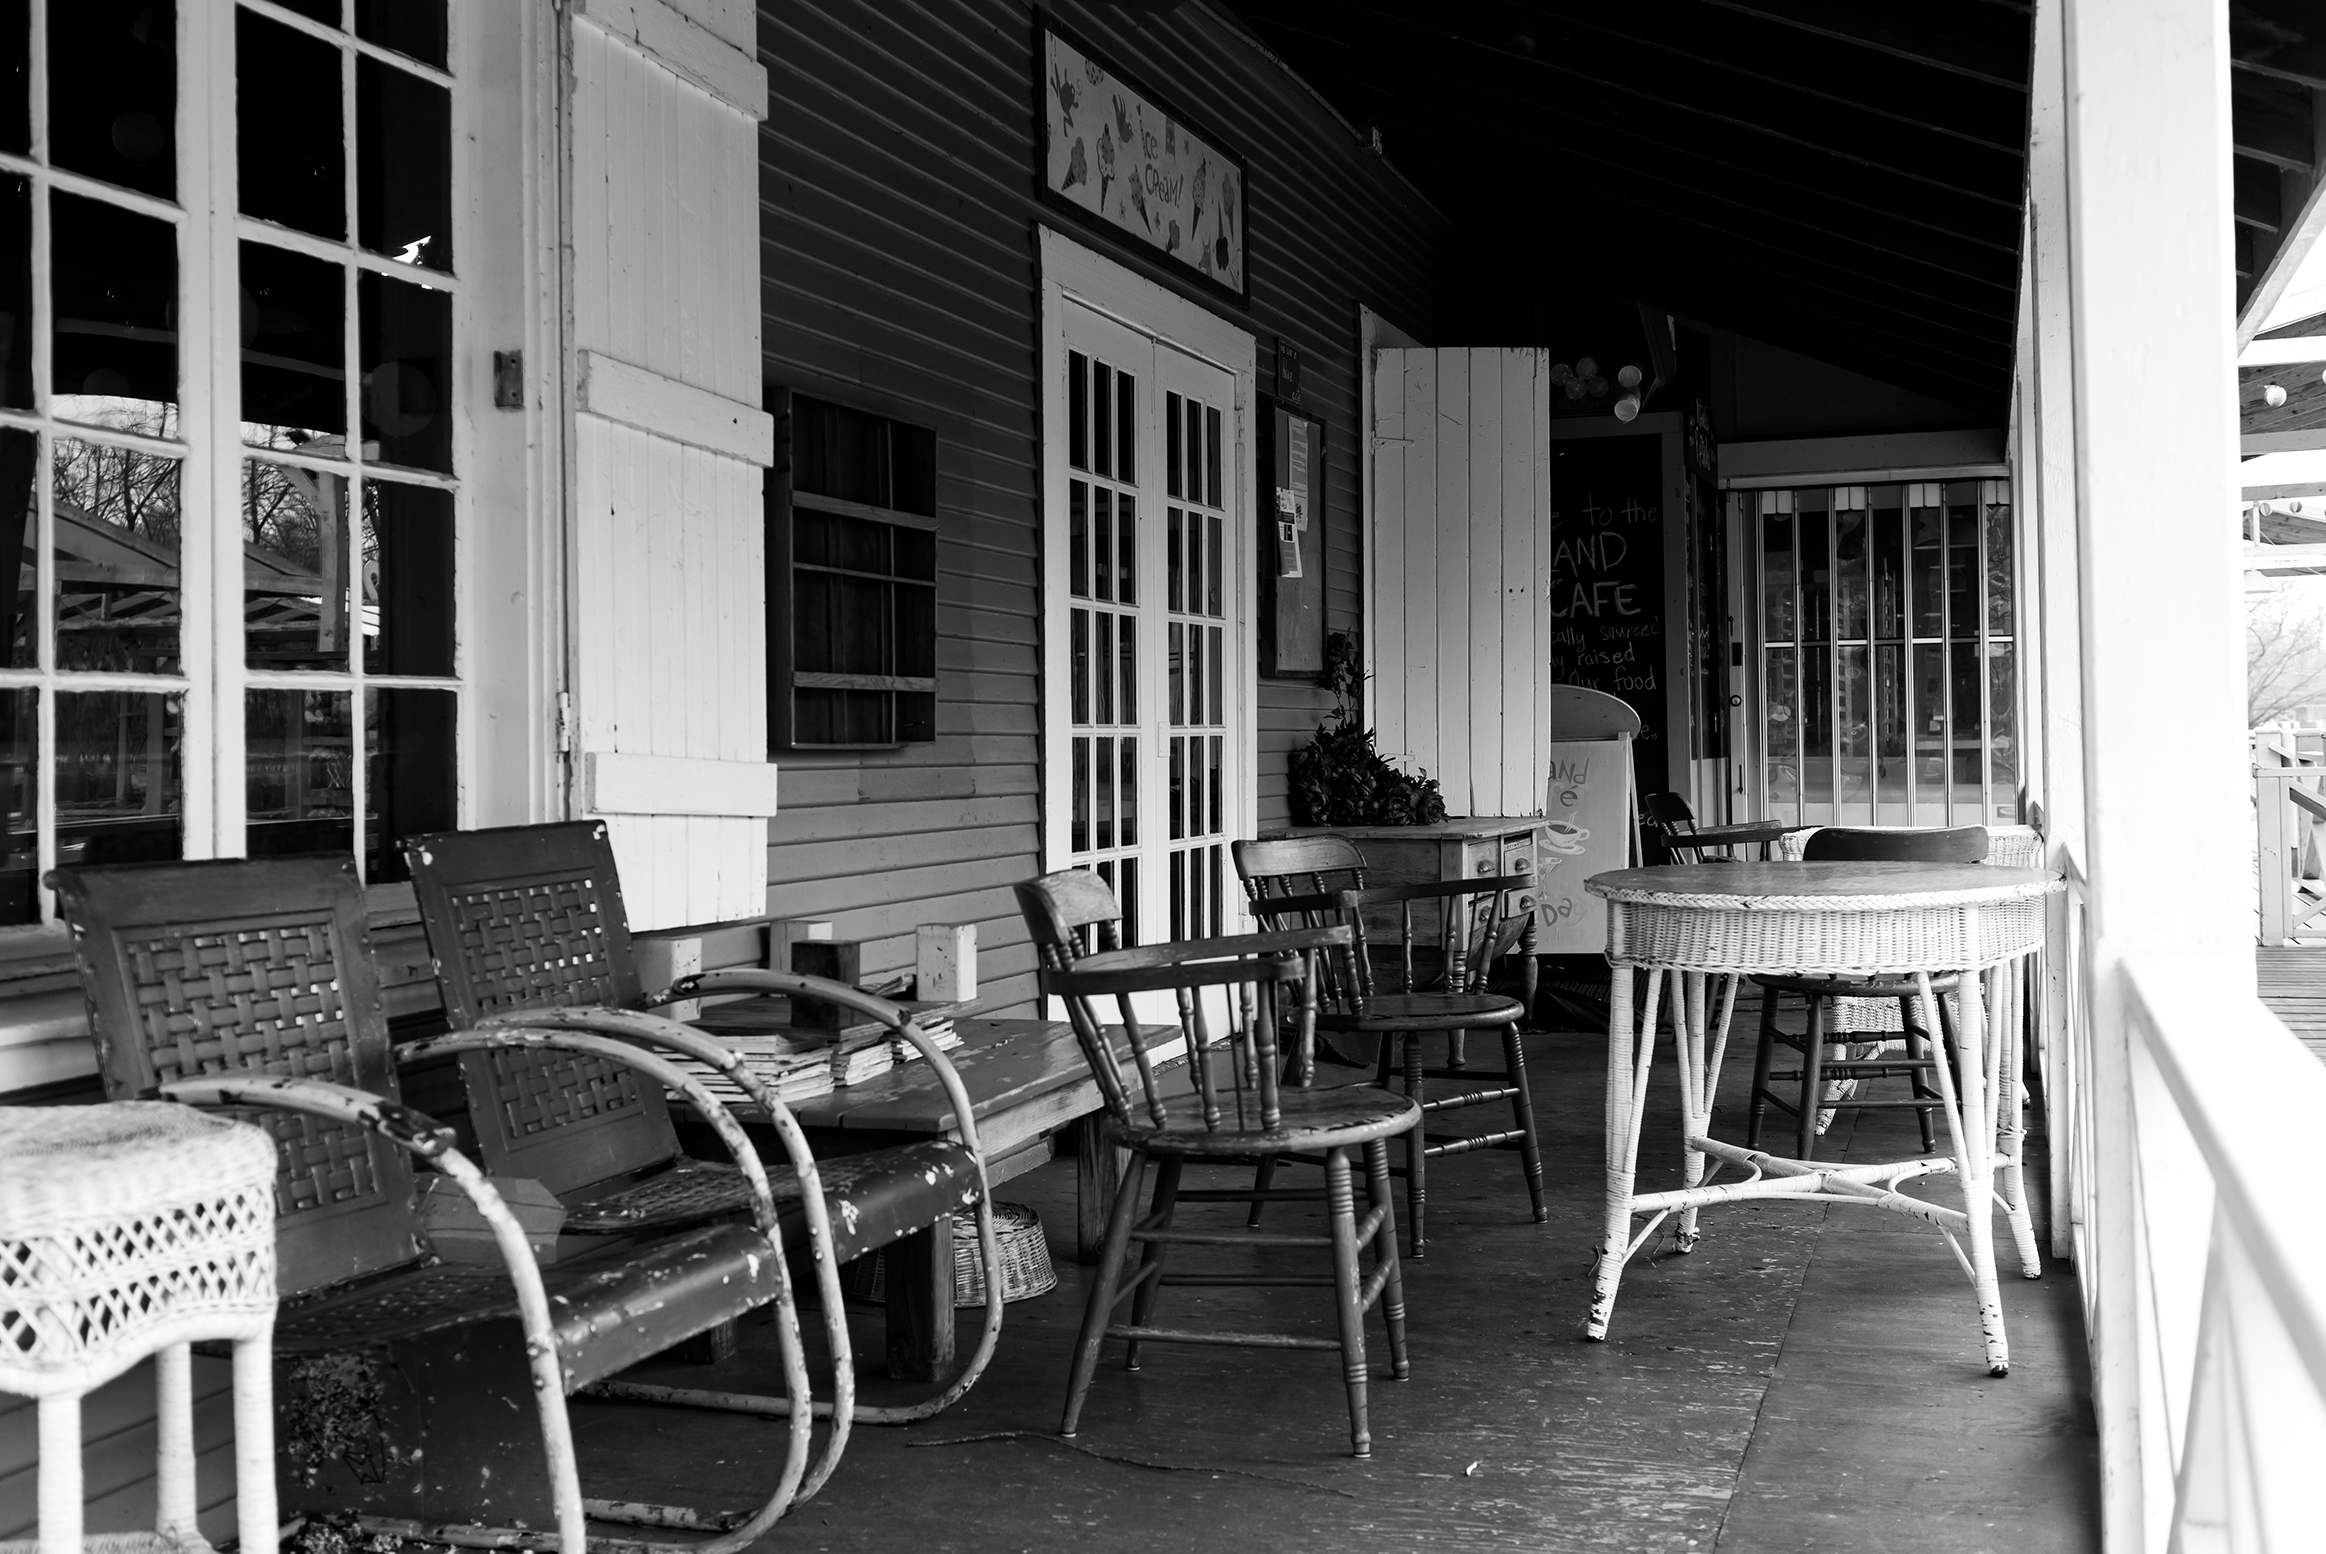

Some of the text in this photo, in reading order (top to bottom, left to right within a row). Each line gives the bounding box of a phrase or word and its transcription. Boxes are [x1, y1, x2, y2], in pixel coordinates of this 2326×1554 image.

[1582, 492, 1613, 526] to
[1621, 496, 1658, 523] the
[1551, 531, 1628, 579] AND
[1577, 640, 1636, 666] raised
[1613, 665, 1657, 691] food
